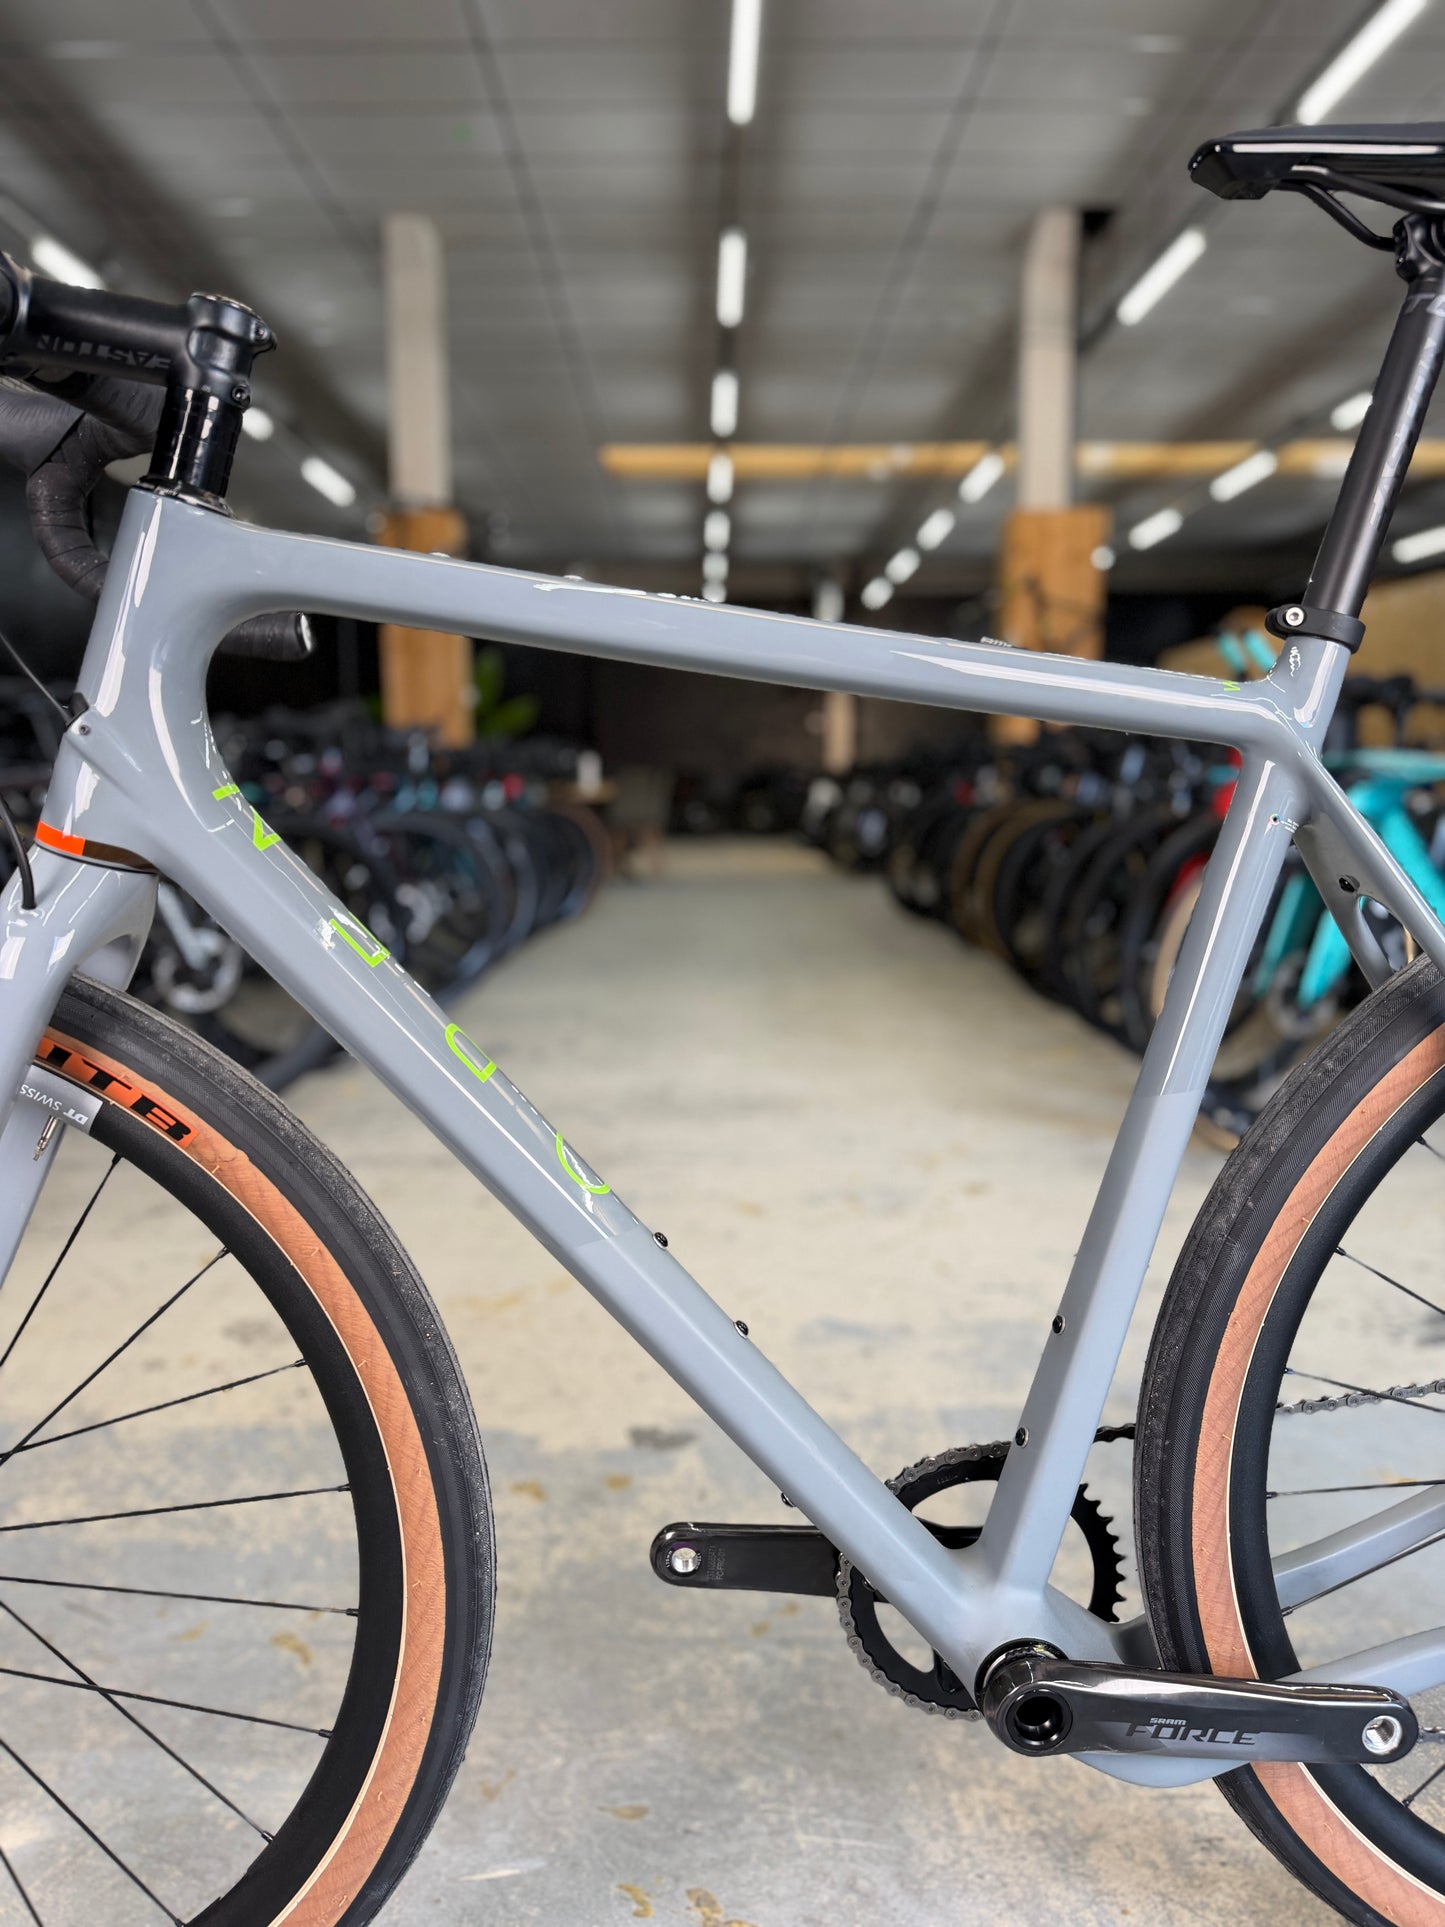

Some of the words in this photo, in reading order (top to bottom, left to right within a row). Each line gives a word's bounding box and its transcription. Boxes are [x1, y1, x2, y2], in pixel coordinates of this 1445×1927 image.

[19, 1083, 63, 1112] SWISS
[36, 1044, 192, 1142] TB
[63, 1107, 89, 1126] DT
[1149, 1717, 1187, 1726] SRAM
[1126, 1722, 1260, 1746] FORCE
